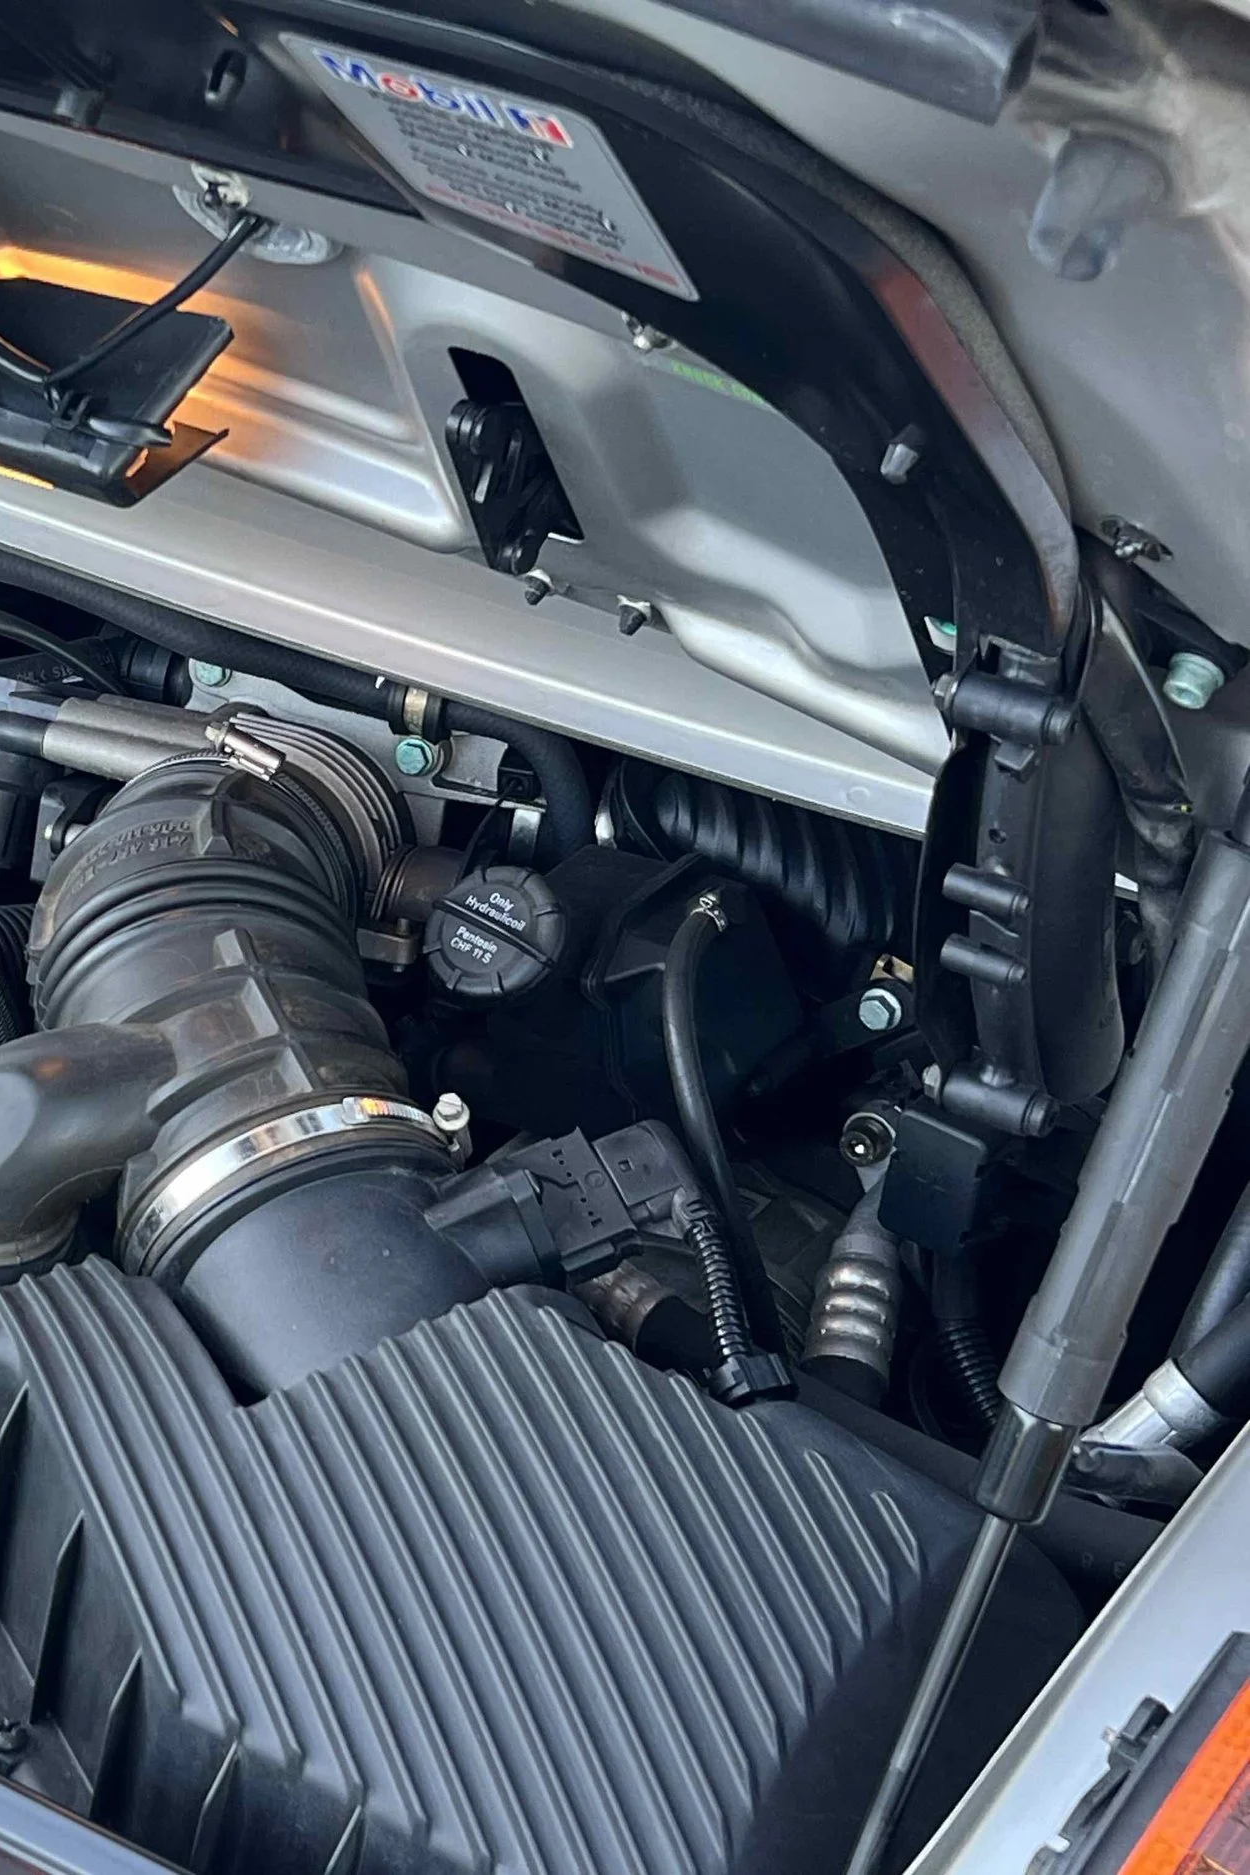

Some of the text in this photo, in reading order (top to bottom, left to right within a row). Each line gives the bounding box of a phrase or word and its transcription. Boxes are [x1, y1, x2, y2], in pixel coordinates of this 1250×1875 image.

[316, 51, 501, 125] Mobil
[465, 895, 526, 931] Hydraulicoil
[490, 893, 514, 912] Only
[450, 937, 493, 964] CHF 11 S
[456, 926, 498, 953] Pentosin
